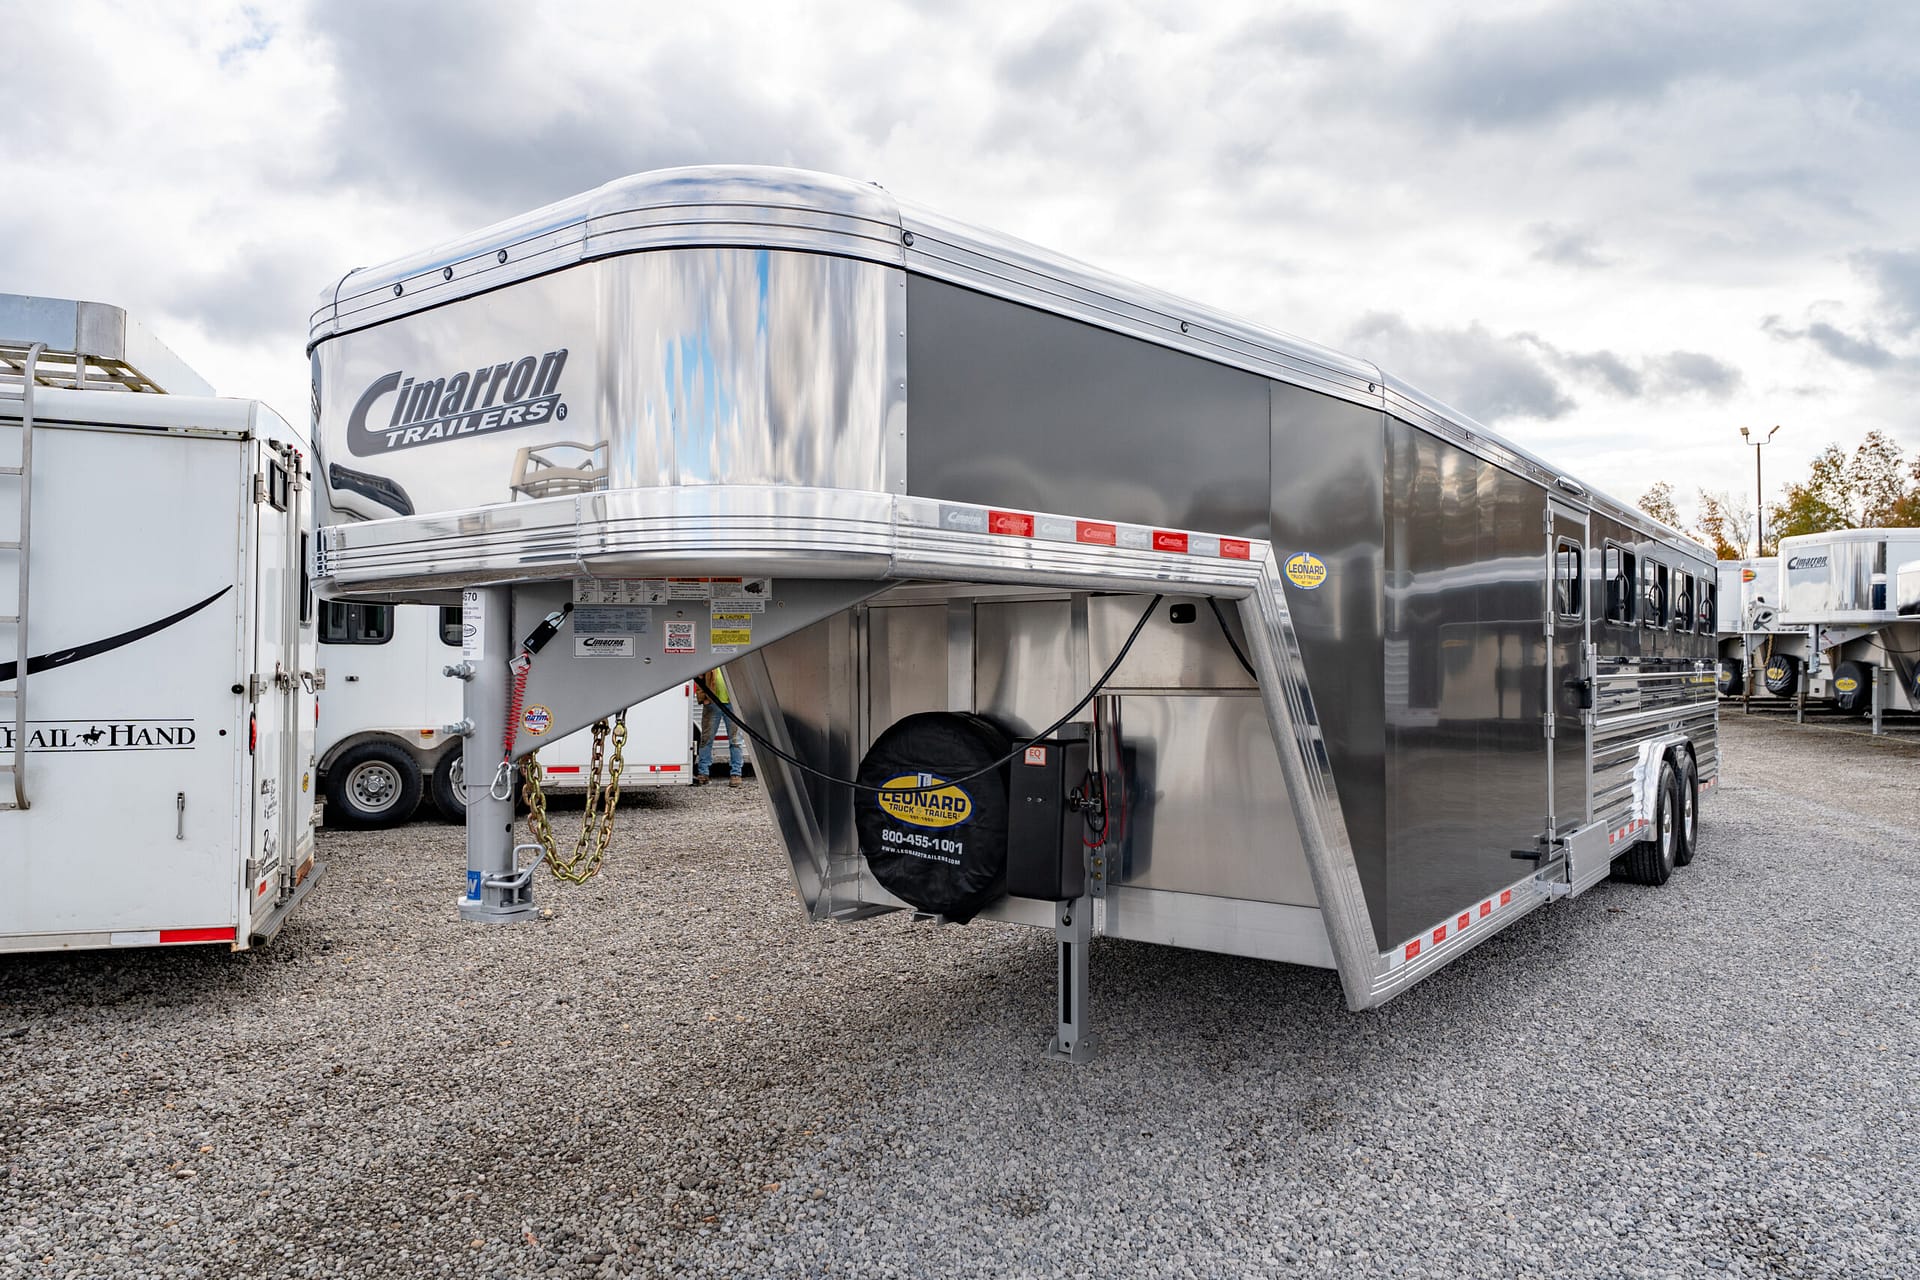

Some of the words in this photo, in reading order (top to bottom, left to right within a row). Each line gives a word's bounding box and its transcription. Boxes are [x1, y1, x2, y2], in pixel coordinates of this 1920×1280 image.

[347, 348, 569, 457] Cimarron
[385, 401, 551, 448] TRAILERS
[1288, 564, 1324, 575] LEONARD
[107, 724, 196, 747] HAND
[1029, 748, 1041, 759] EQ
[881, 792, 967, 813] LEONARD
[889, 803, 914, 814] TRUCK
[925, 808, 957, 820] TRAILER
[881, 828, 964, 855] 800-455-1001
